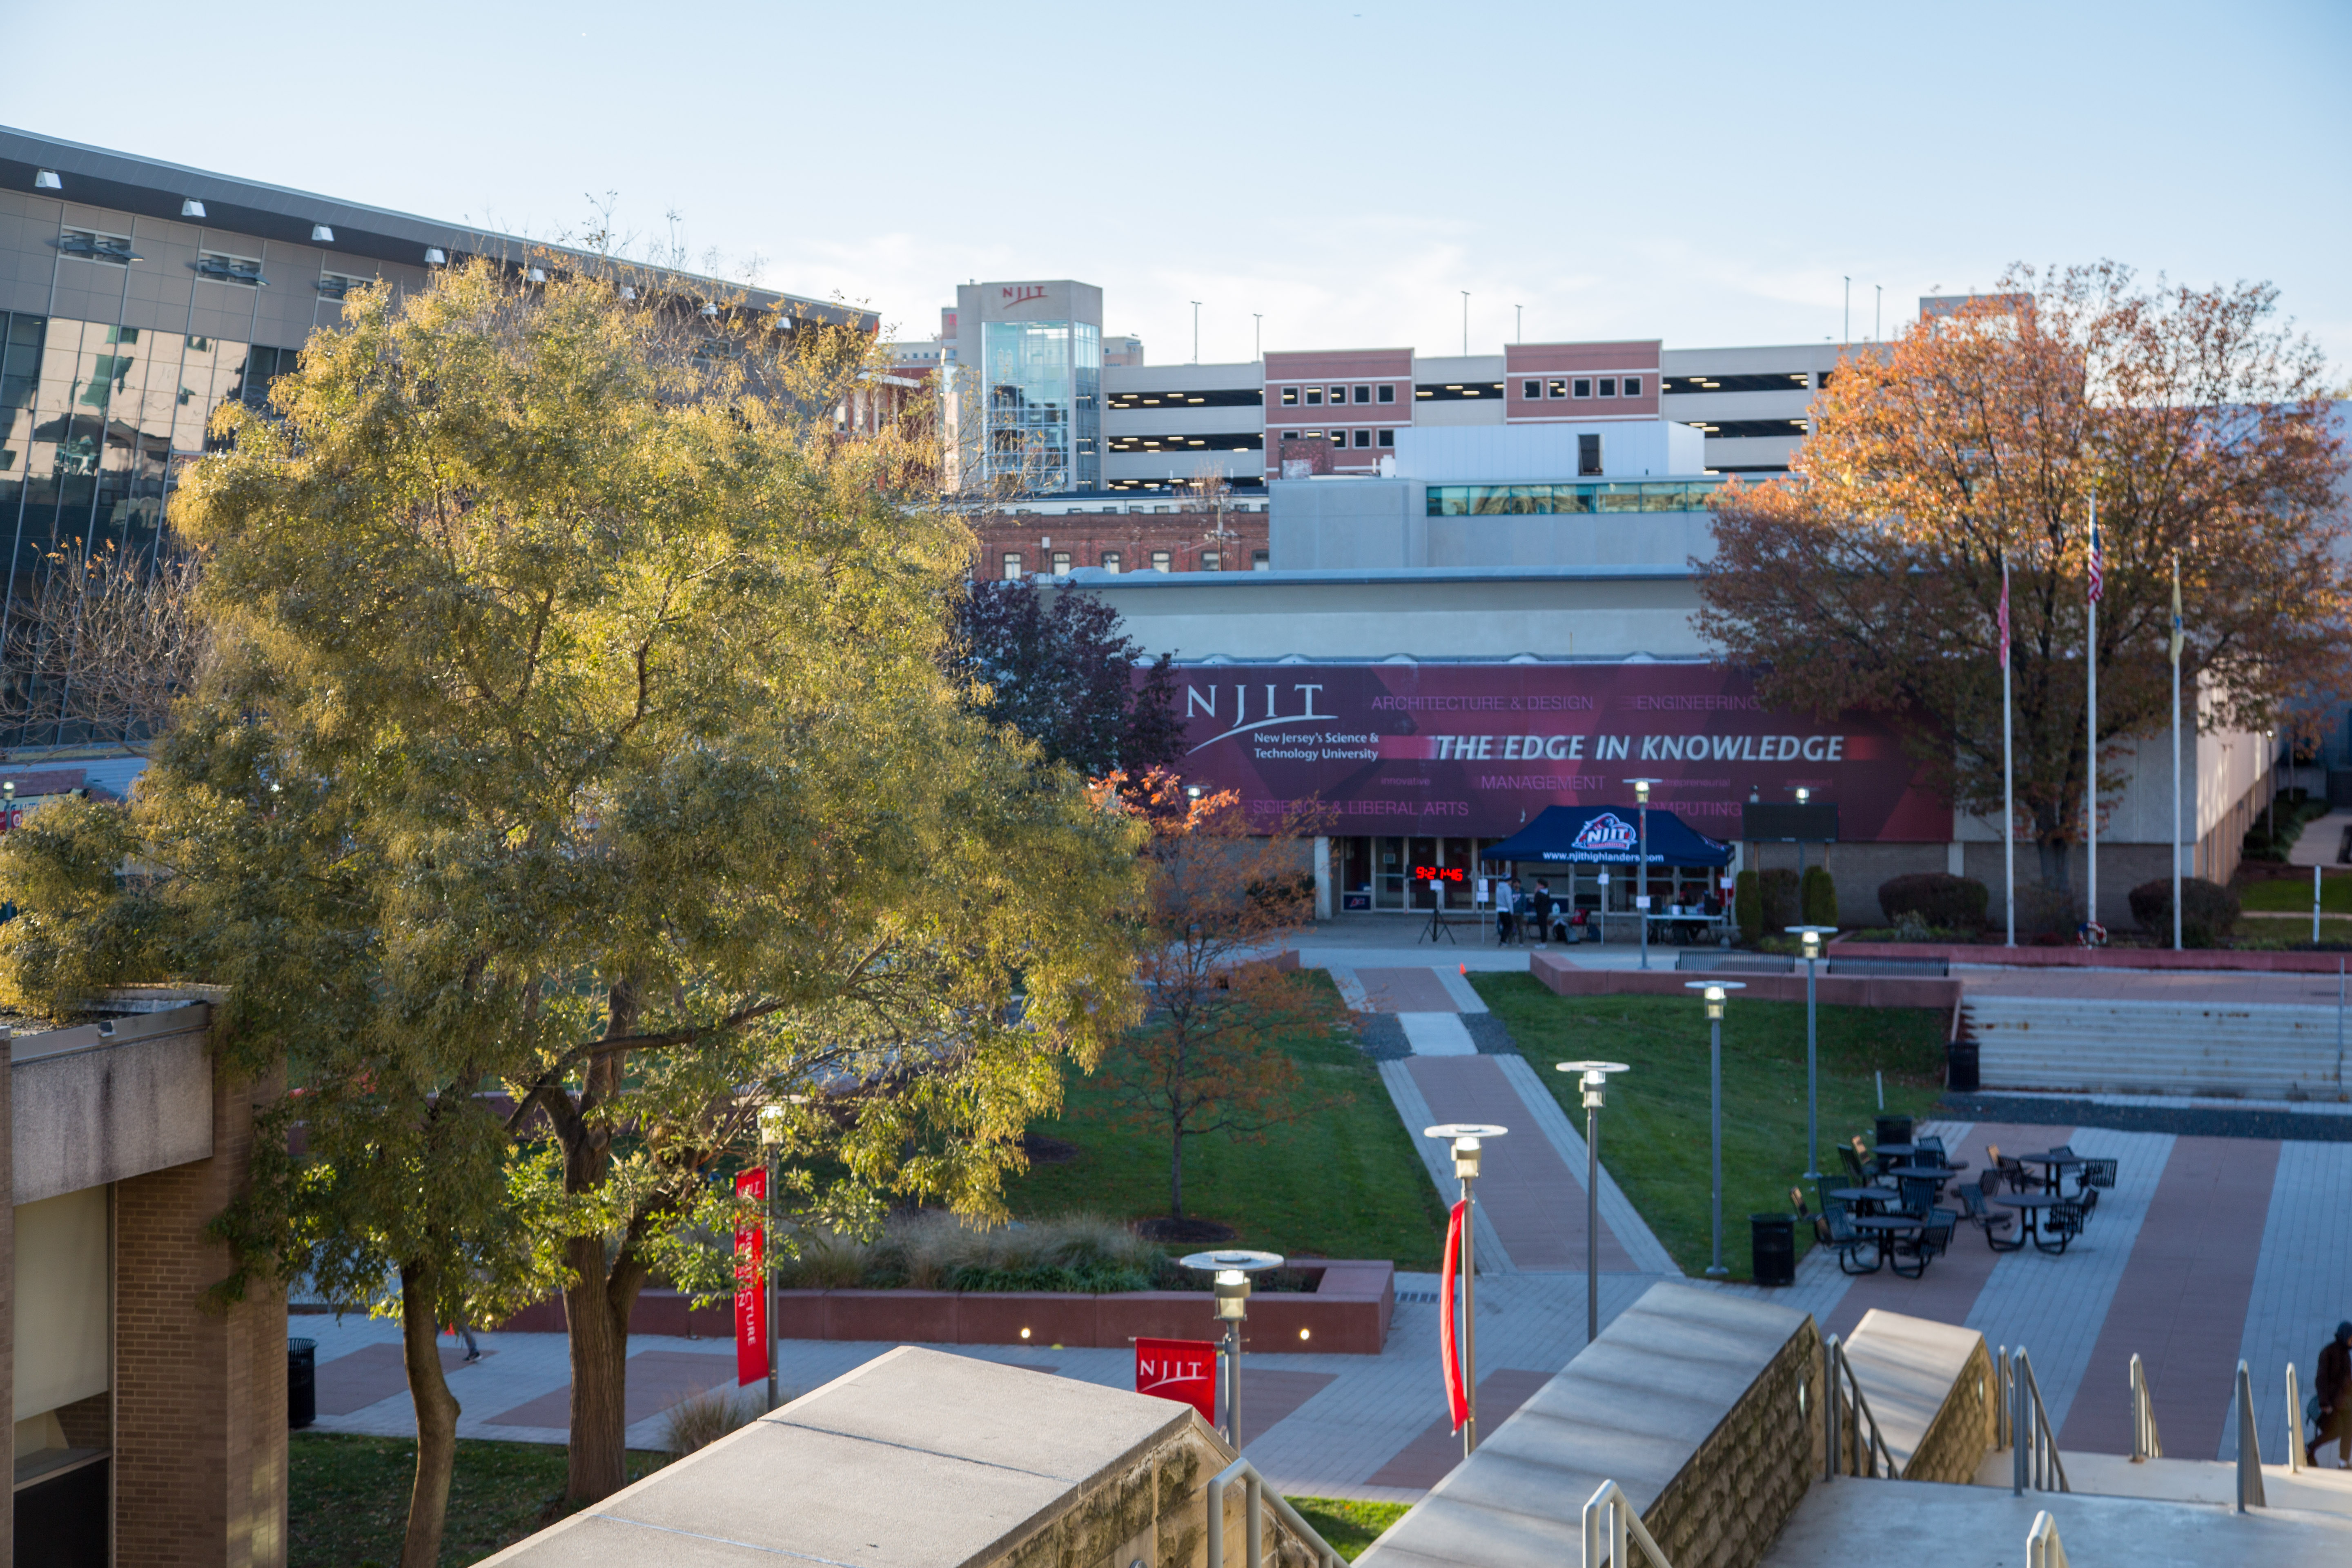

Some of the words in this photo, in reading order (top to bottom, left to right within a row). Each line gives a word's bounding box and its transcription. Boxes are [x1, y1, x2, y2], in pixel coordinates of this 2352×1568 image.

[1002, 285, 1044, 298] NJIT
[1186, 684, 1323, 728] NJIT
[1372, 696, 1503, 710] ARCHITECTURE
[1511, 696, 1521, 710] &
[1528, 696, 1593, 710] DESIGN
[1637, 695, 1760, 710] ENGINEERING
[1254, 733, 1279, 743] New
[1325, 733, 1367, 743] Science
[1370, 733, 1379, 743] &
[1254, 748, 1319, 762] Technology
[1322, 748, 1379, 762] University
[1437, 735, 1492, 760] THE
[1503, 735, 1584, 760] EDGE
[1596, 735, 1630, 760] IN
[1640, 735, 1844, 761] KNOWLEDGE
[1481, 776, 1605, 790] MANAGEMENT
[1253, 800, 1327, 814] SCIENCE
[1332, 800, 1343, 814] &
[1348, 802, 1418, 815] LIBERAL
[1423, 802, 1469, 815] ARTS
[1633, 801, 1742, 816] OMPUTING
[1587, 828, 1628, 843] NJIT
[1543, 851, 1664, 863] www.njithighlanderscom
[1140, 1359, 1202, 1382] NJIT
